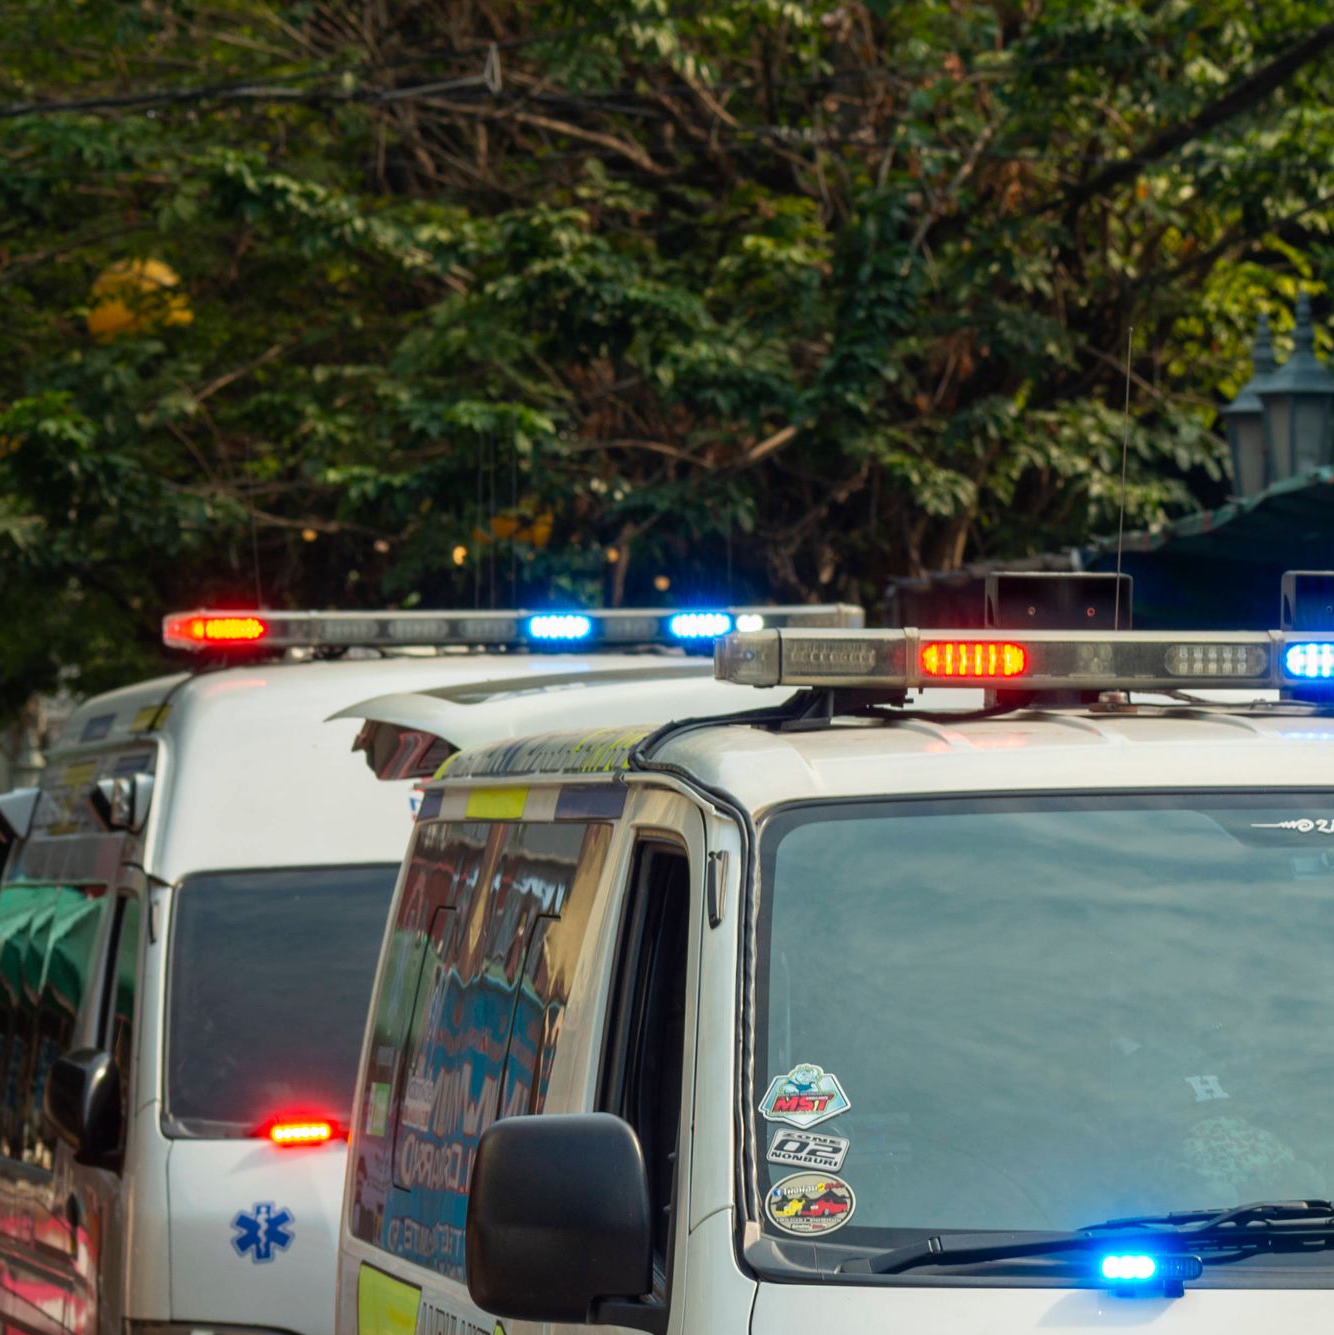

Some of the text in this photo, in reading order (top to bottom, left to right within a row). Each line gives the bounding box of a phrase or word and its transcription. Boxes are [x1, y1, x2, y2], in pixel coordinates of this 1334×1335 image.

[772, 1094, 835, 1112] MST
[774, 1139, 842, 1160] 02
[770, 1151, 839, 1167] NONBURI
